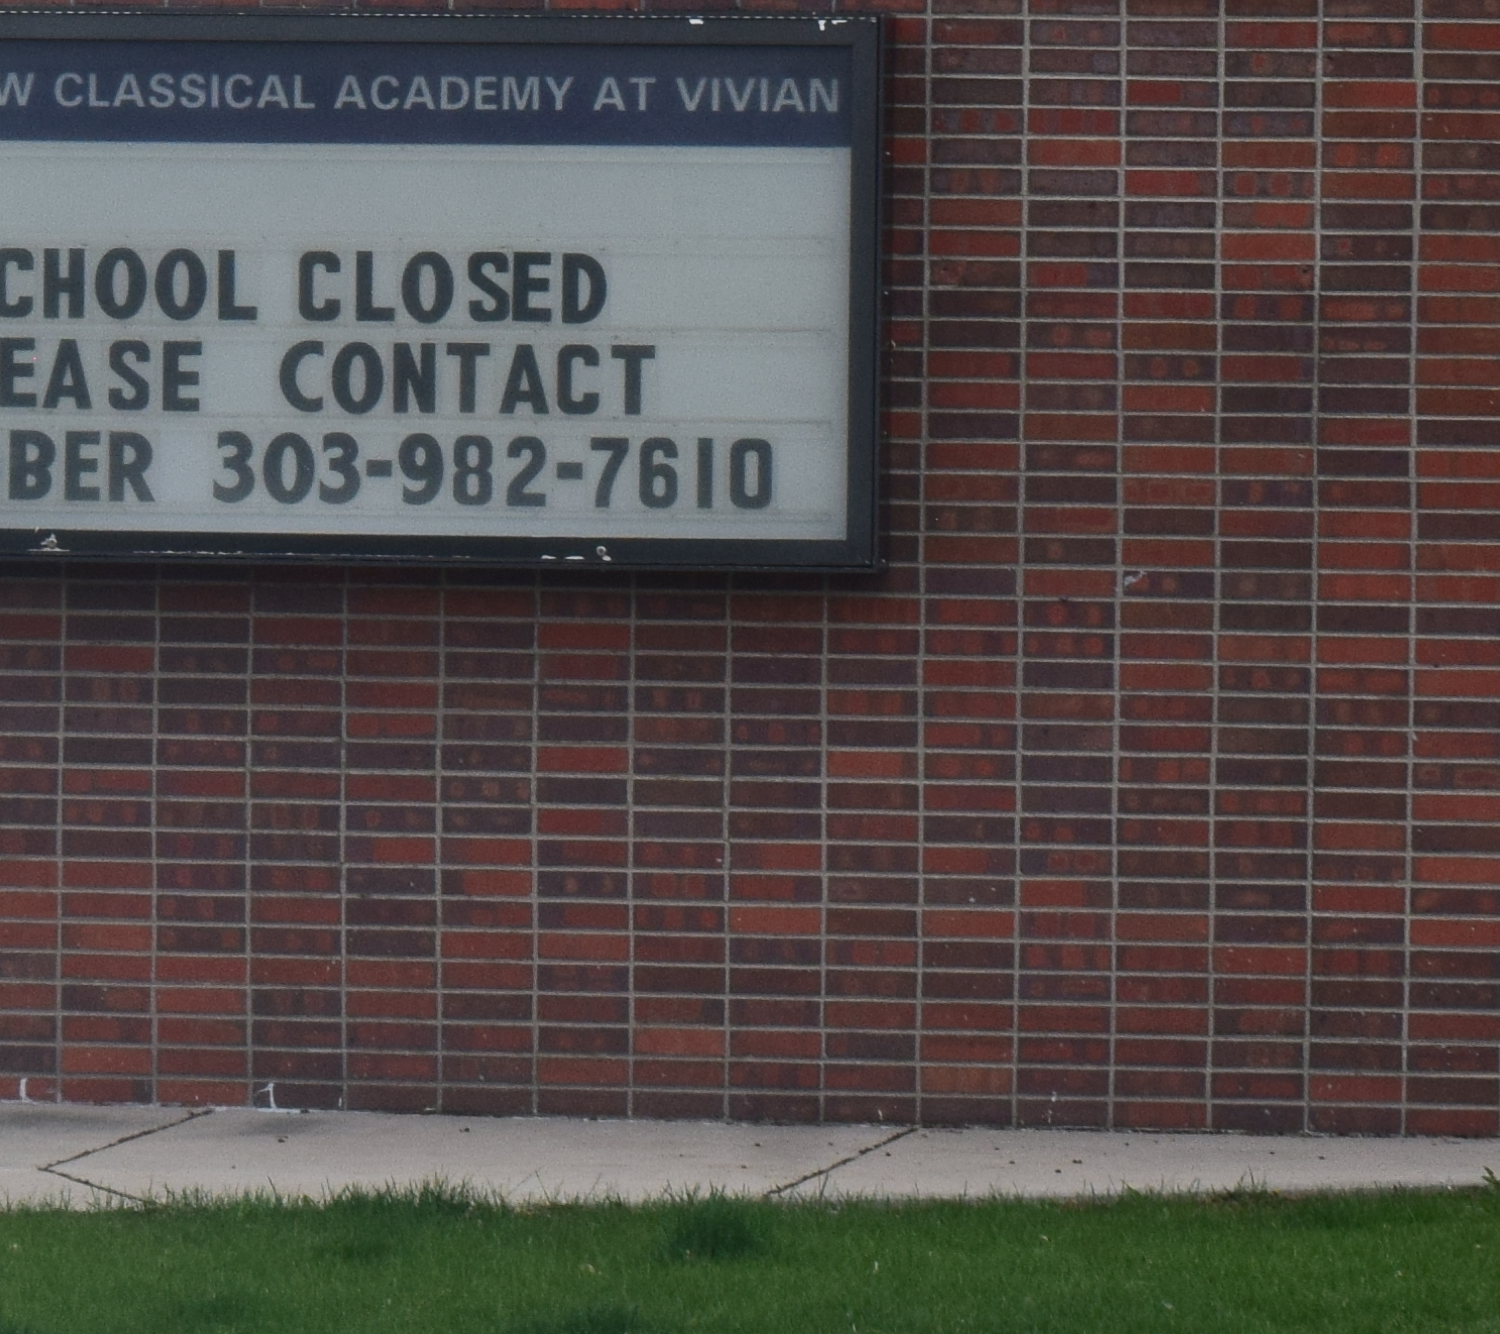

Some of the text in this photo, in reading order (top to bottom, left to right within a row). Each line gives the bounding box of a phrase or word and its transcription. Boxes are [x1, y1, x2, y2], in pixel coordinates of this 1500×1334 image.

[53, 72, 316, 111] CLASSICAL
[333, 75, 576, 113] ACADEMY
[591, 77, 656, 113] AT
[675, 77, 841, 115] VIVIAN
[297, 249, 607, 327] CLOSED
[279, 341, 657, 417] CONTACT
[213, 431, 774, 511] 303-982-7610
